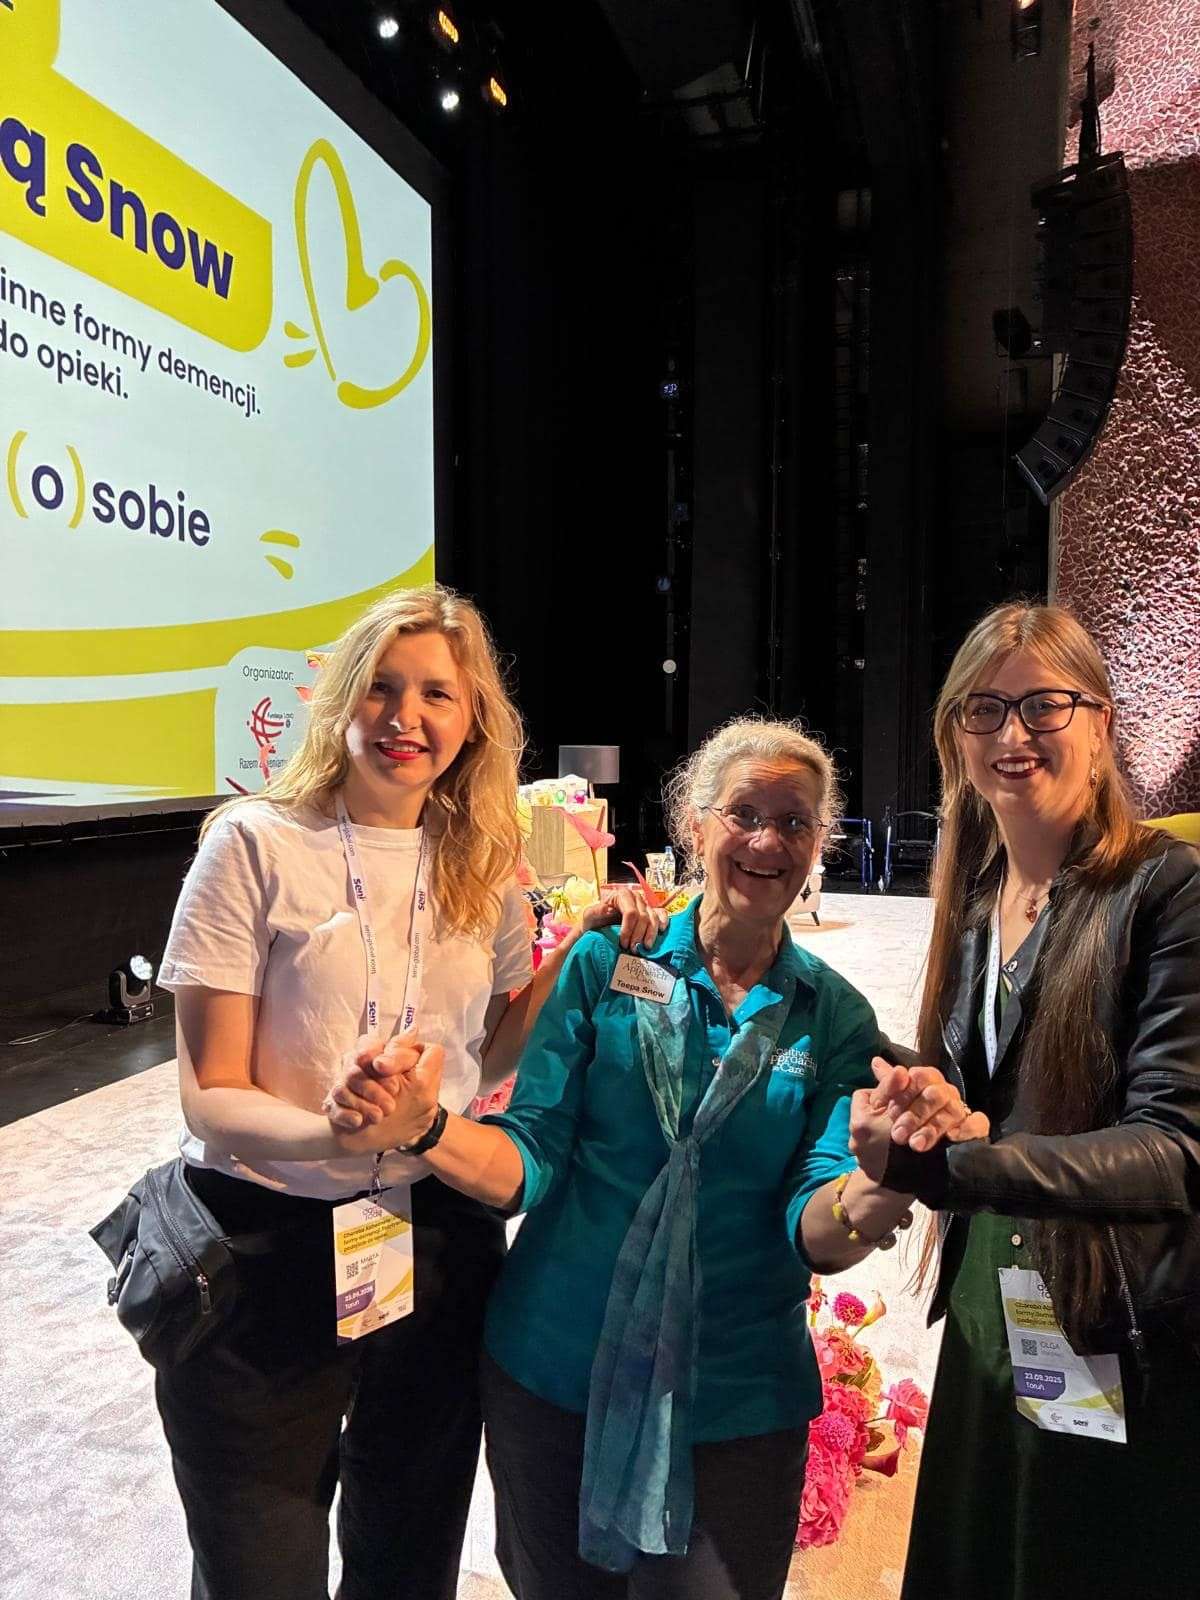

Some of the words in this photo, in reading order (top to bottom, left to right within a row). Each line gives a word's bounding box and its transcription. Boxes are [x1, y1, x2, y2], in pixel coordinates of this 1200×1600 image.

[66, 143, 234, 300] Snow
[1, 267, 66, 326] inne
[74, 304, 152, 372] formy
[158, 347, 261, 416] demencji.
[37, 344, 128, 399] opieki.
[243, 665, 294, 681] Organizator:
[353, 878, 366, 901] seni
[417, 889, 426, 912] seni
[617, 979, 640, 992] Teepa
[642, 985, 665, 999] Snow
[368, 1001, 378, 1027] seni
[403, 1004, 415, 1030] seni
